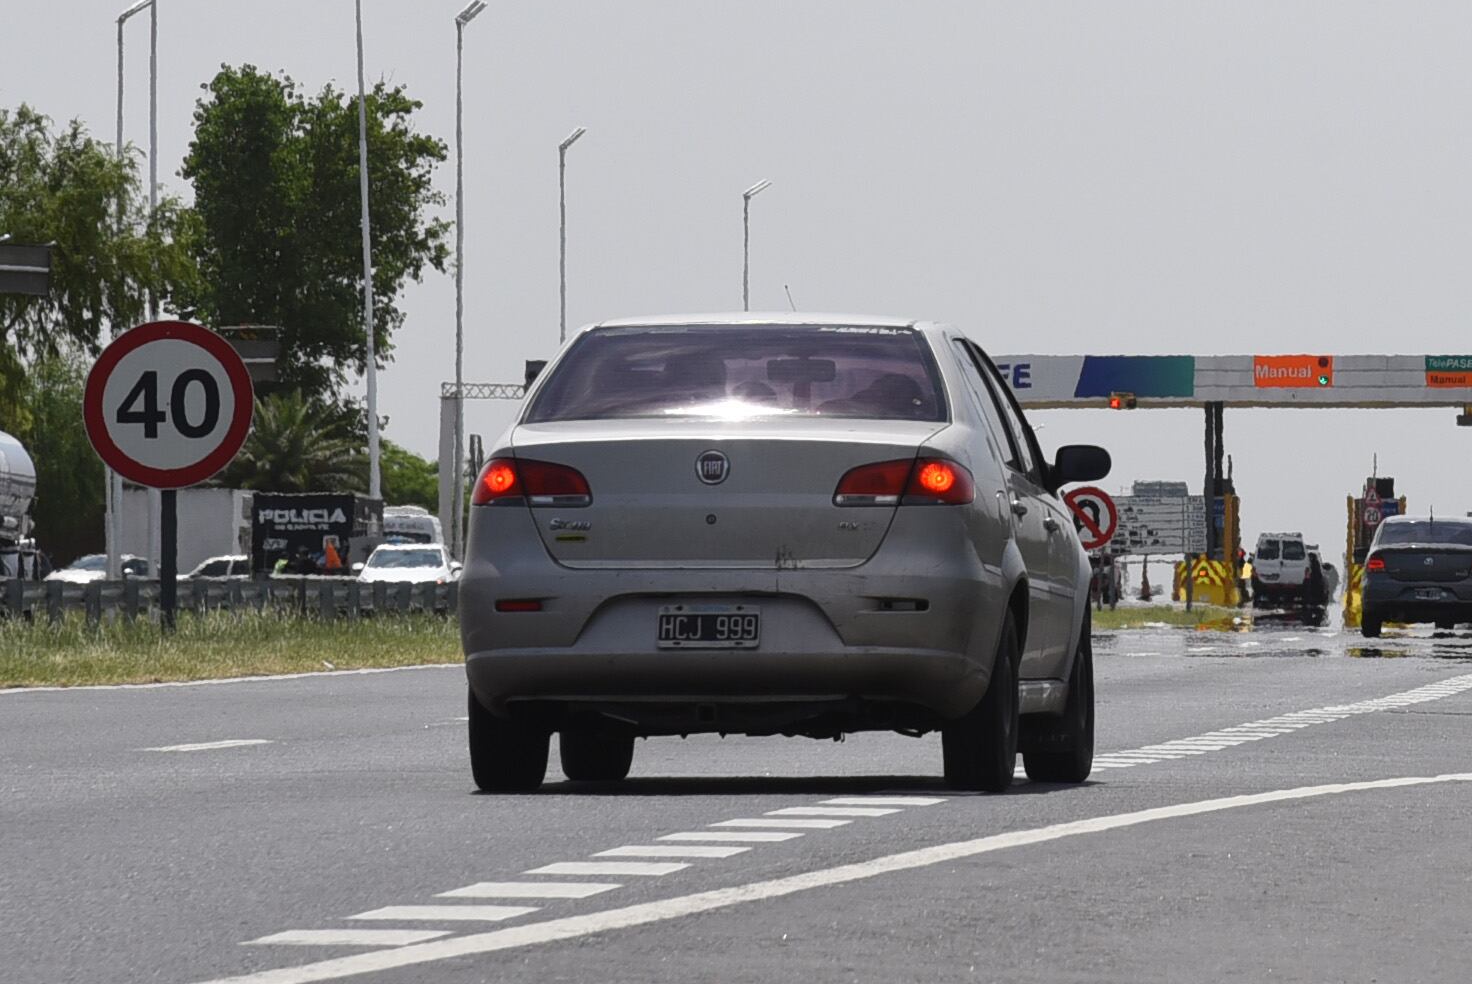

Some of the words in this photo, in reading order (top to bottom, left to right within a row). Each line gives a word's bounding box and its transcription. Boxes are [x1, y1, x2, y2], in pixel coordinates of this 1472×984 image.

[1255, 365, 1312, 379] Manual
[1430, 375, 1466, 384] Manual
[116, 368, 220, 439] 40
[703, 460, 722, 476] FIAT
[259, 508, 347, 524] POLICIA
[661, 616, 701, 639] HCJ
[716, 616, 757, 639] 999
